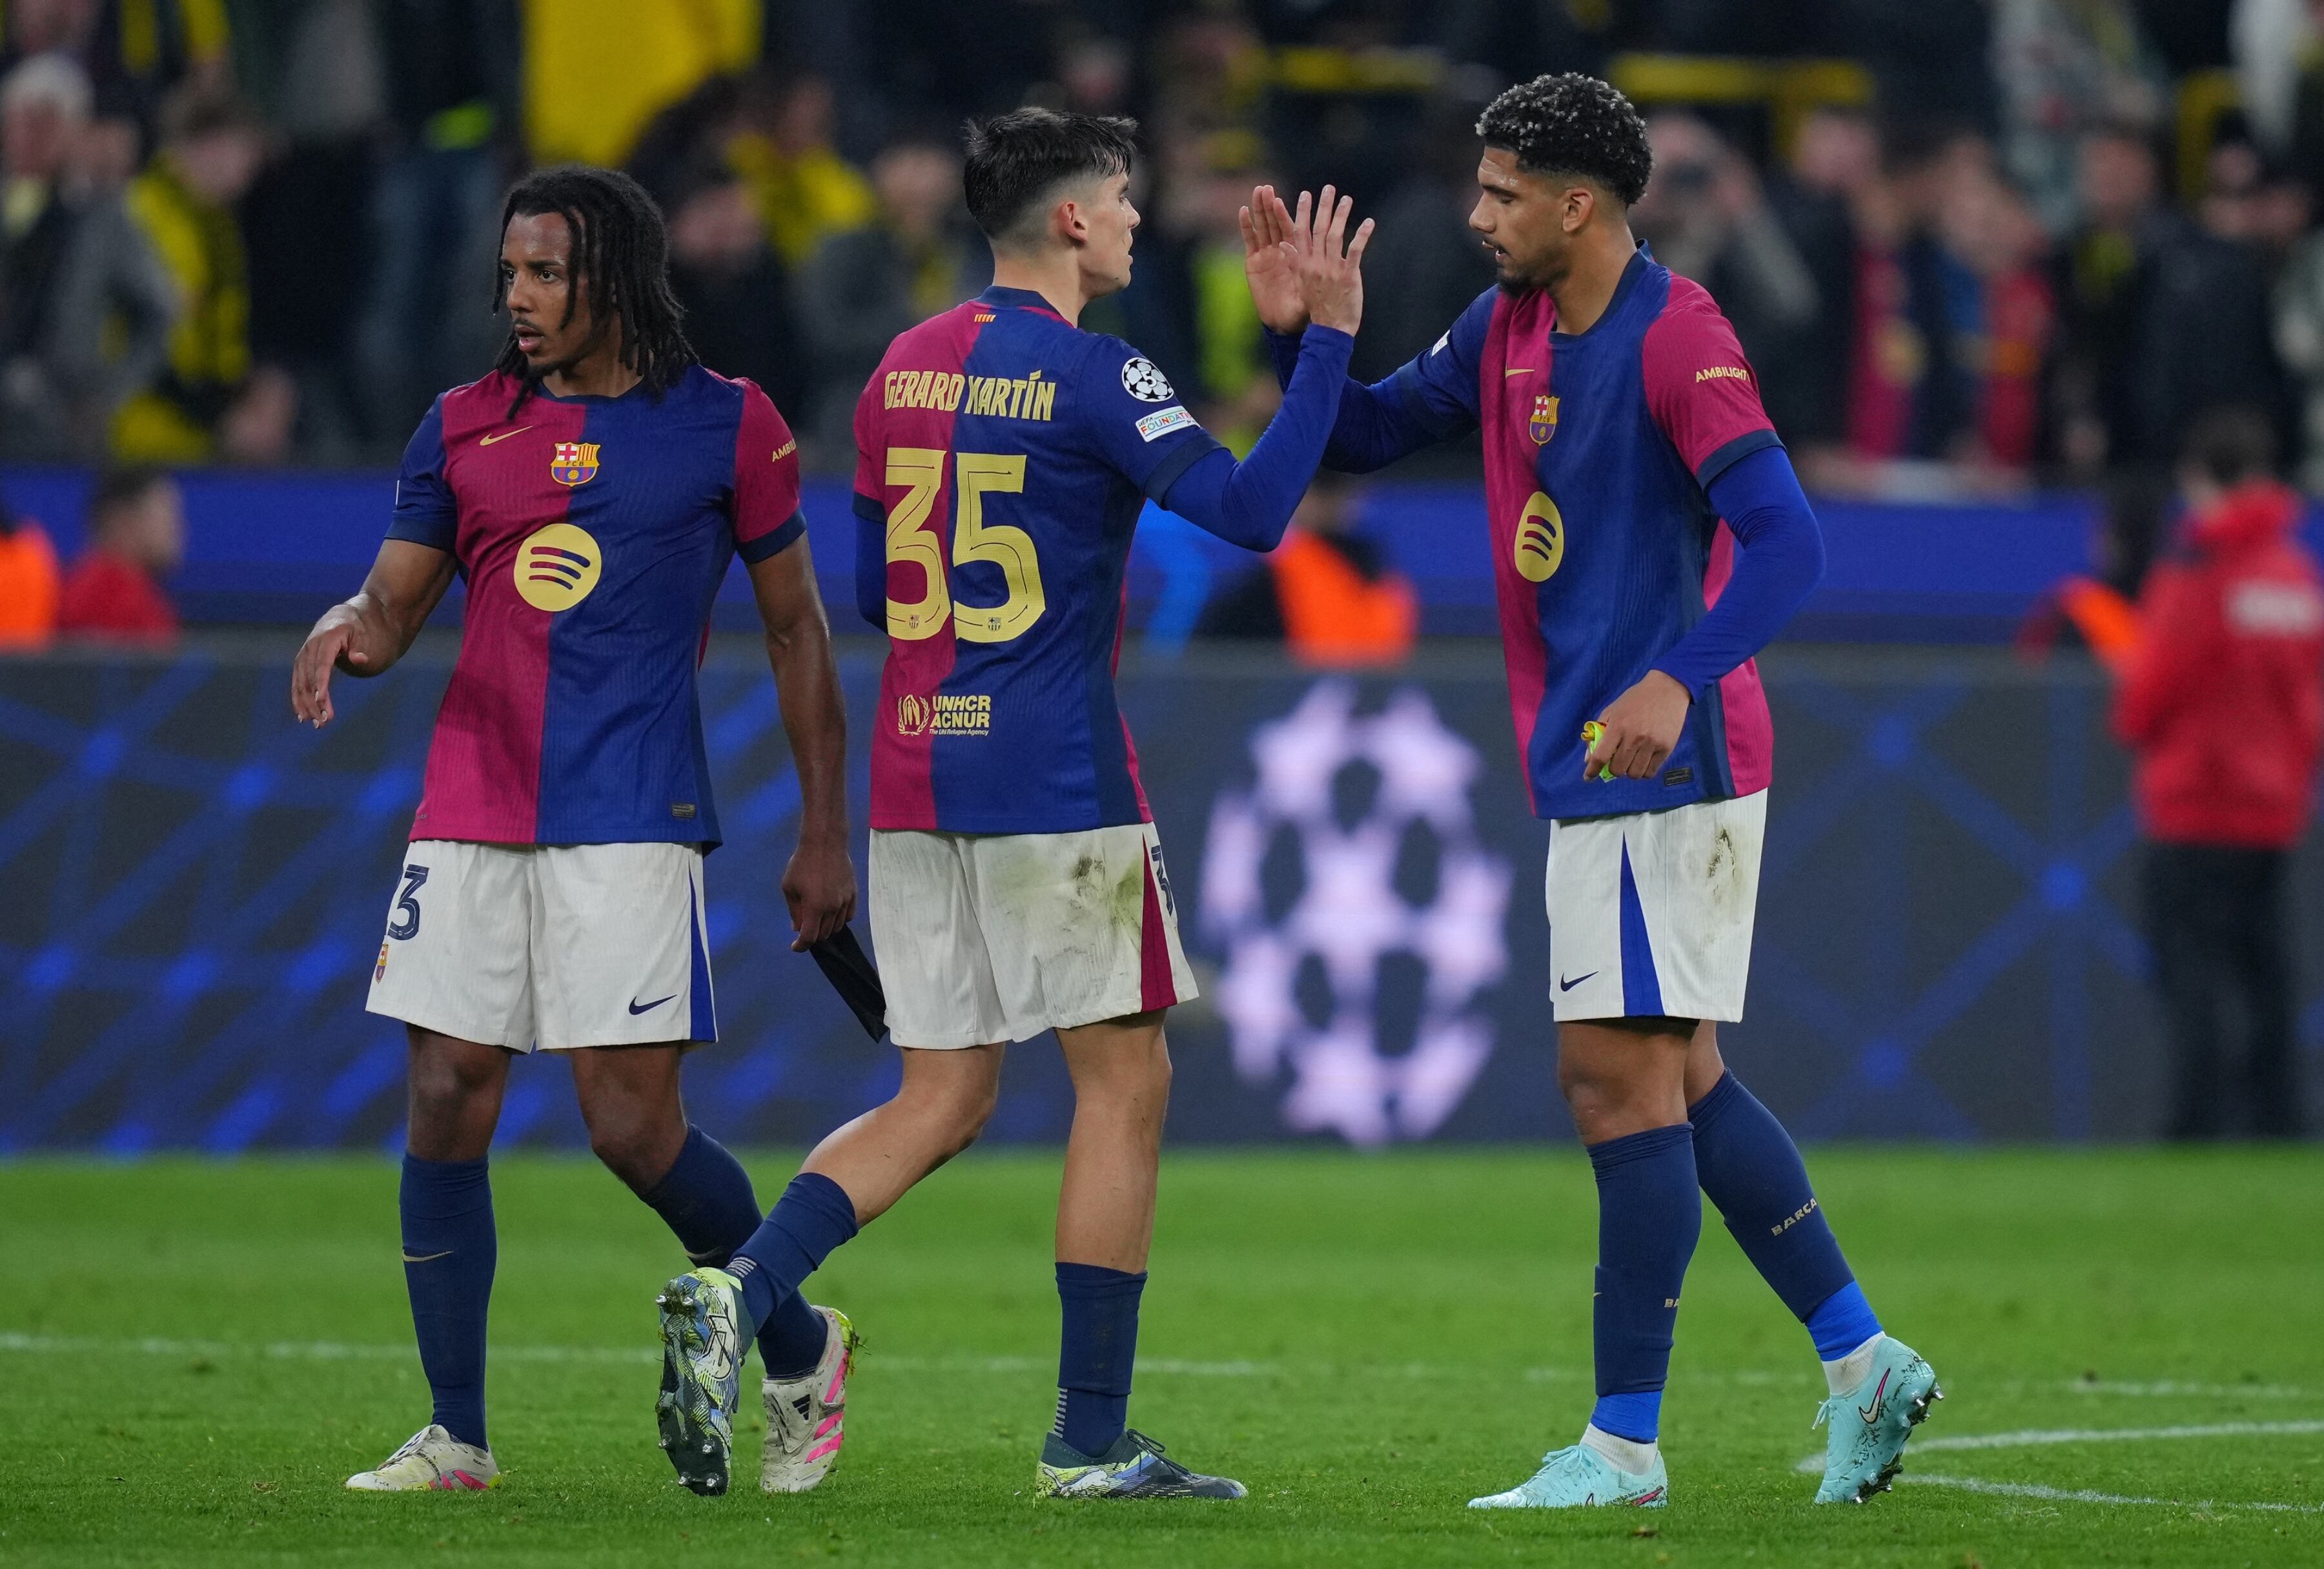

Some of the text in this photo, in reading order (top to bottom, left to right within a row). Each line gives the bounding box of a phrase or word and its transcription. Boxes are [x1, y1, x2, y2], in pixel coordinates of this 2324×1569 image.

[1696, 366, 1747, 383] AMBILIGHT
[884, 371, 966, 411] GERARD
[1138, 416, 1154, 427] UEFA
[885, 447, 1046, 643] 35
[932, 695, 992, 712] UNHCR
[930, 712, 990, 728] ACNUR
[967, 728, 989, 737] Agency
[387, 864, 430, 941] 3
[1771, 1198, 1817, 1236] BARÇA
